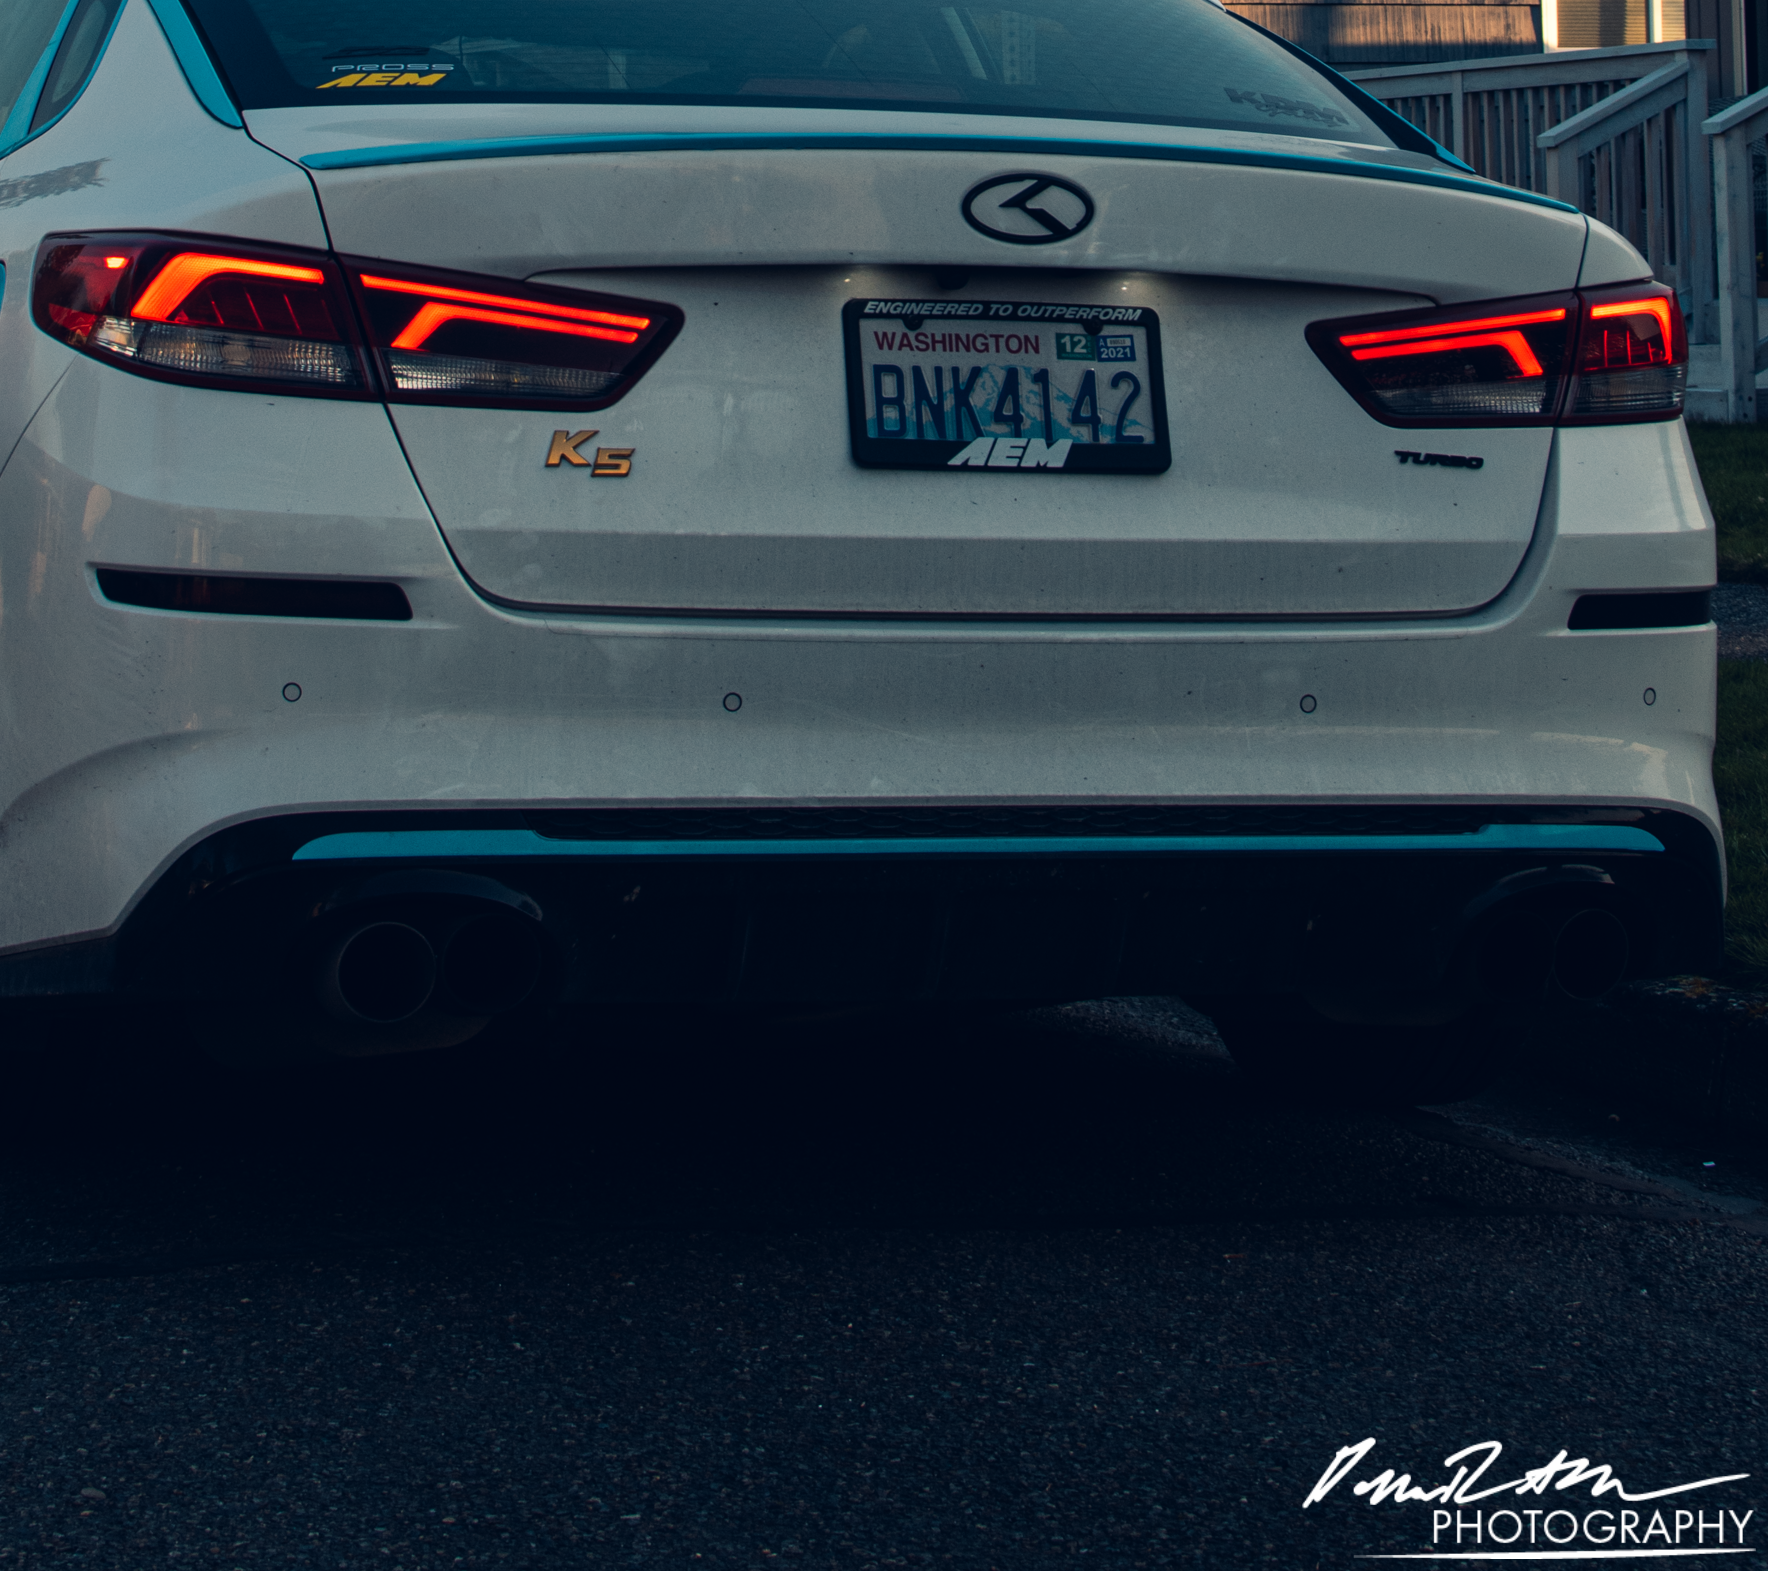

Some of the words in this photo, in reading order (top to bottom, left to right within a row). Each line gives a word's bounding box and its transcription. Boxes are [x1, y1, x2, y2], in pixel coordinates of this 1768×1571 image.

[331, 63, 455, 73] PROSS
[315, 72, 447, 89] AEM
[863, 301, 984, 316] ENGINEERED
[988, 303, 1013, 317] TO
[1017, 305, 1143, 321] OUTPERFORM
[873, 331, 1041, 354] WASHINGTON
[1060, 335, 1087, 353] 12
[1100, 347, 1131, 358] 2021
[873, 363, 1145, 443] BNK4142
[545, 430, 636, 477] K5
[947, 436, 1073, 468] AEM
[1394, 450, 1484, 469] TURBO
